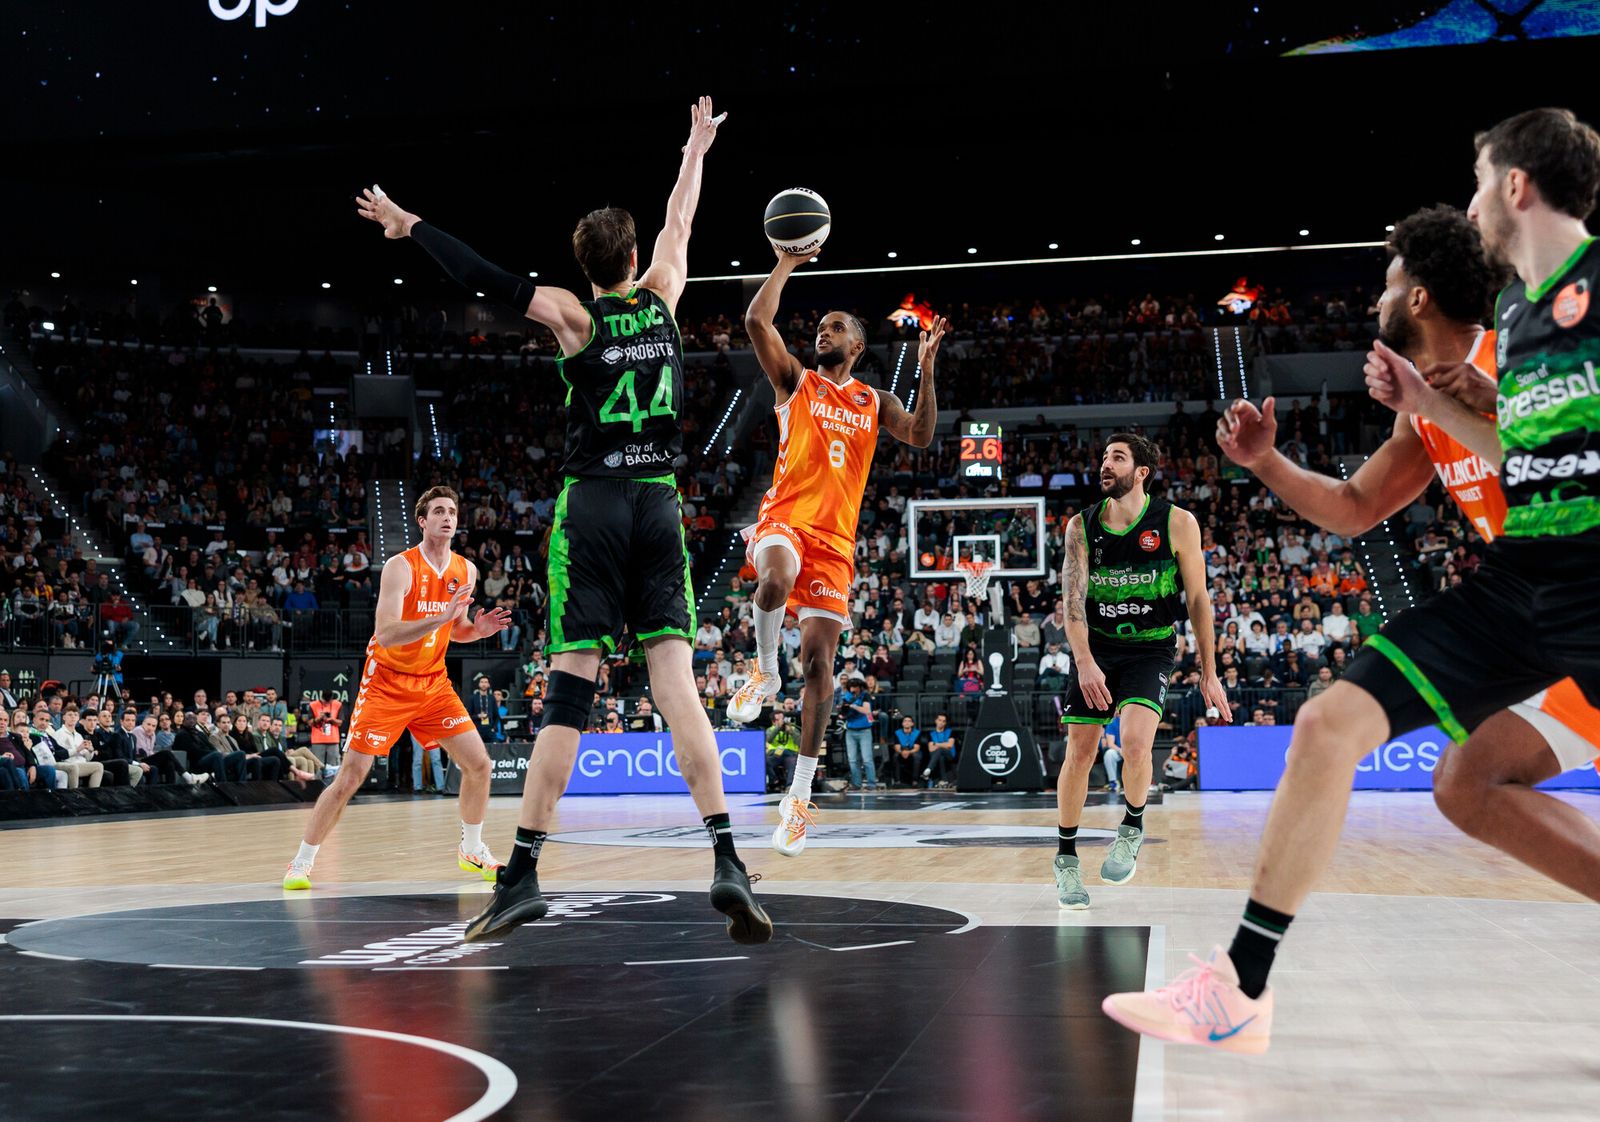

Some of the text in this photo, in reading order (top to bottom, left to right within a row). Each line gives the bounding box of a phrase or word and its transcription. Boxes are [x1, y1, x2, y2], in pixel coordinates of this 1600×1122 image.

[624, 342, 674, 361] PROBIT
[1515, 370, 1539, 387] Som
[599, 366, 677, 432] 44
[810, 400, 872, 432] VALENCIA
[822, 420, 856, 436] BASKET
[625, 442, 653, 454] City of
[829, 440, 846, 468] 8
[960, 438, 997, 460] 2.6
[625, 449, 678, 466] BADAL
[810, 580, 847, 602] Midea
[417, 600, 450, 613] VALENC
[303, 690, 349, 702] SALDA
[497, 759, 515, 769] del
[578, 740, 746, 777] enda
[496, 771, 518, 779] 2026
